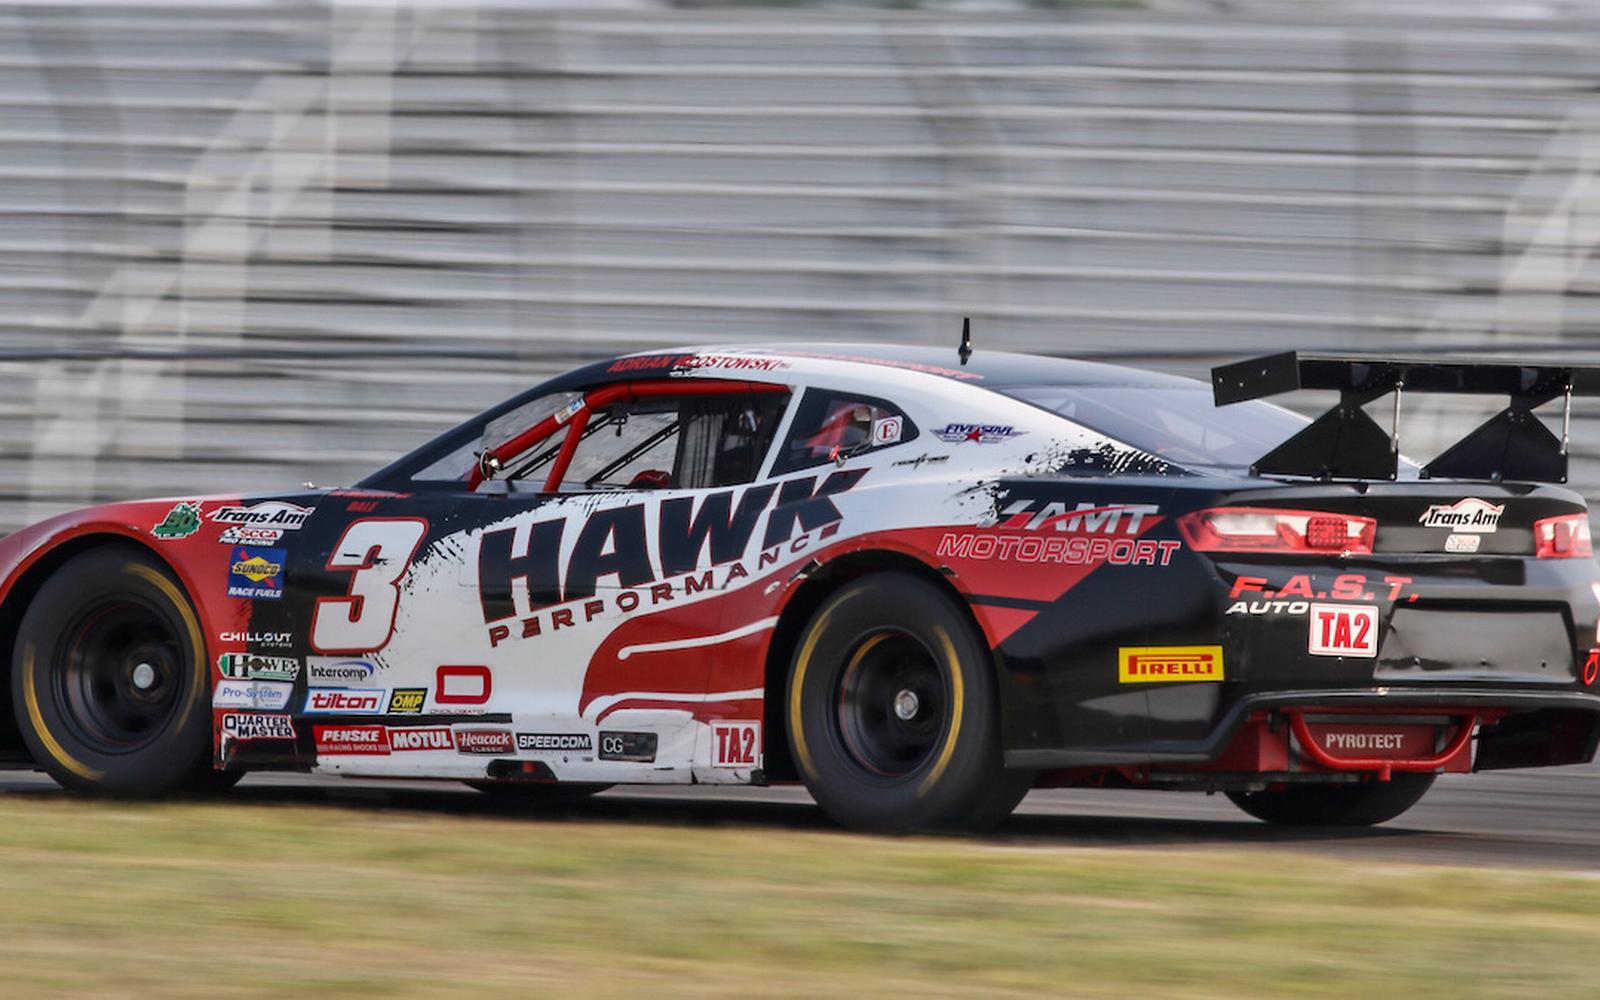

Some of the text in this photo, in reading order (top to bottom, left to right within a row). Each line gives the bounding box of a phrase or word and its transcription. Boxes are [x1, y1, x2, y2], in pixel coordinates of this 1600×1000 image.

[216, 508, 306, 524] Trans Am
[1024, 502, 1159, 534] AMT
[1424, 509, 1498, 525] Trans Am
[240, 530, 278, 538] SCCA
[478, 472, 872, 624] HAWK
[936, 533, 1181, 566] MOTORSPORT
[234, 563, 280, 575] SUNOCO
[228, 587, 282, 598] RACE FUELS
[310, 519, 428, 653] 3
[1225, 601, 1310, 615] AUTO
[219, 632, 292, 642] CHILLOUT
[1318, 612, 1371, 649] TA2
[1128, 654, 1214, 675] PIRELLI
[311, 665, 368, 682] Intercomp
[222, 688, 282, 700] Pro-System
[312, 693, 378, 710] tilton
[392, 696, 423, 708] OMP
[225, 716, 289, 730] QUARTER
[238, 726, 292, 738] MASTER
[322, 729, 380, 743] PENSKE
[393, 731, 452, 748] MOTUL
[462, 731, 510, 747] Heacock
[519, 735, 590, 749] SPEEDCOM
[715, 727, 755, 764] TA2
[1326, 734, 1404, 749] PYROTECT
